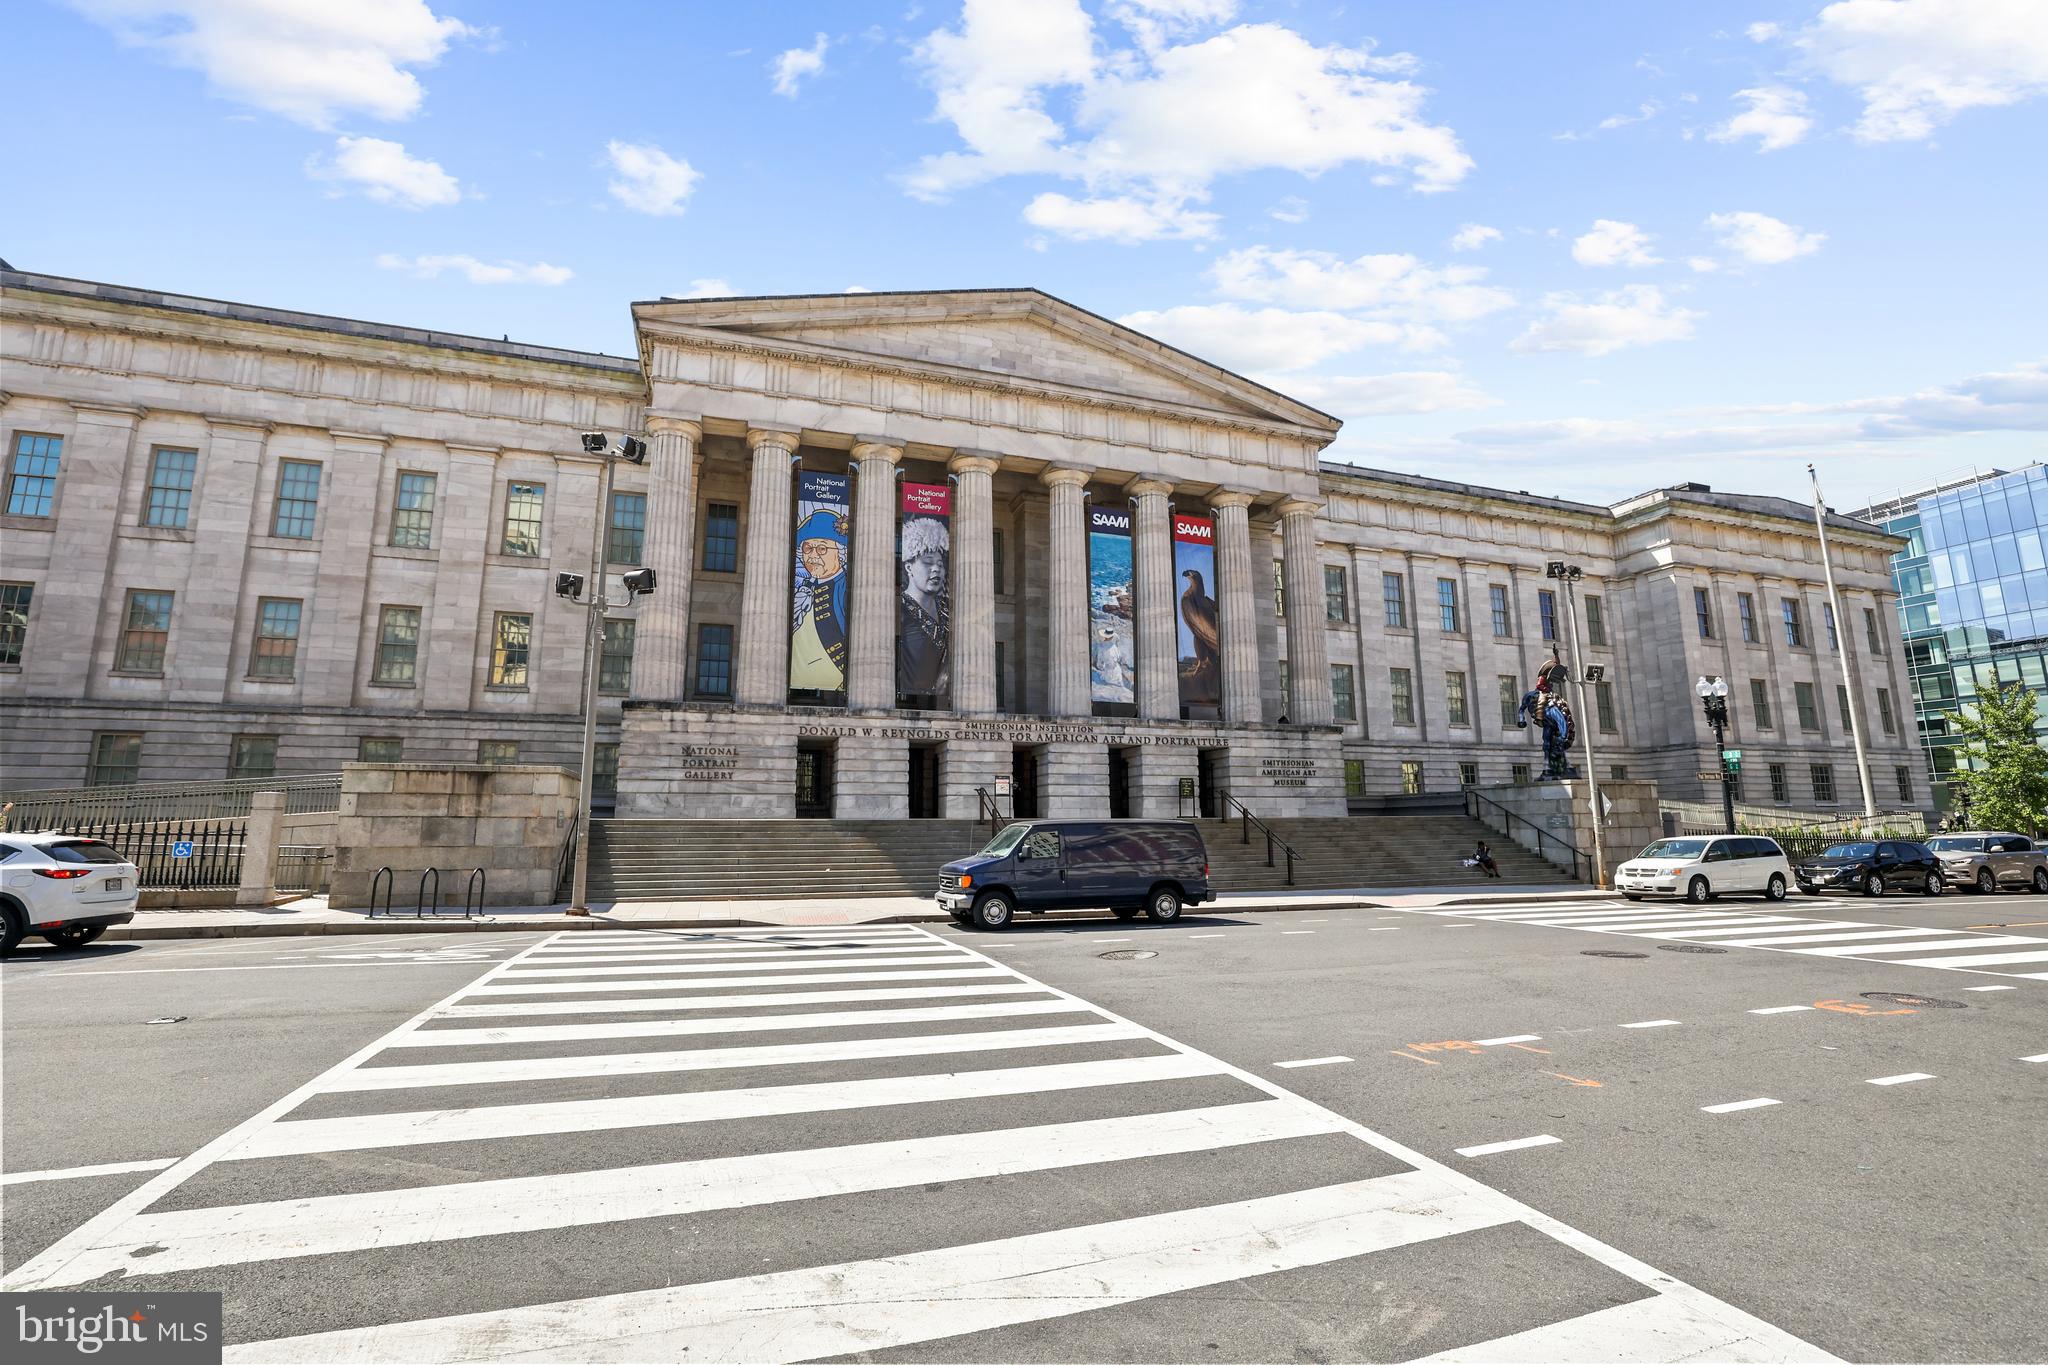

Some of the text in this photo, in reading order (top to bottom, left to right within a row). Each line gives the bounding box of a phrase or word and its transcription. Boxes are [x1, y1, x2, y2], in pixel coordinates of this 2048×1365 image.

[804, 483, 830, 492] Portrait
[816, 477, 846, 488] National
[815, 491, 841, 501] Gallery
[918, 488, 946, 498] National
[907, 494, 931, 503] Portrait
[917, 502, 942, 512] Gallery
[1092, 513, 1129, 529] SAAM
[1176, 522, 1212, 538] SAAM
[965, 722, 1094, 733] SMITHSONIAN INSTITUTION
[800, 726, 1229, 747] DONALD W. REYNOLDS CENTER FOR AMERICAN ART AND PORTRAITURE
[681, 746, 739, 756] NATIONAL
[682, 759, 739, 768] PORTRAIT
[1262, 759, 1315, 767] SMITHSONIAN
[684, 771, 734, 780] GALLERY
